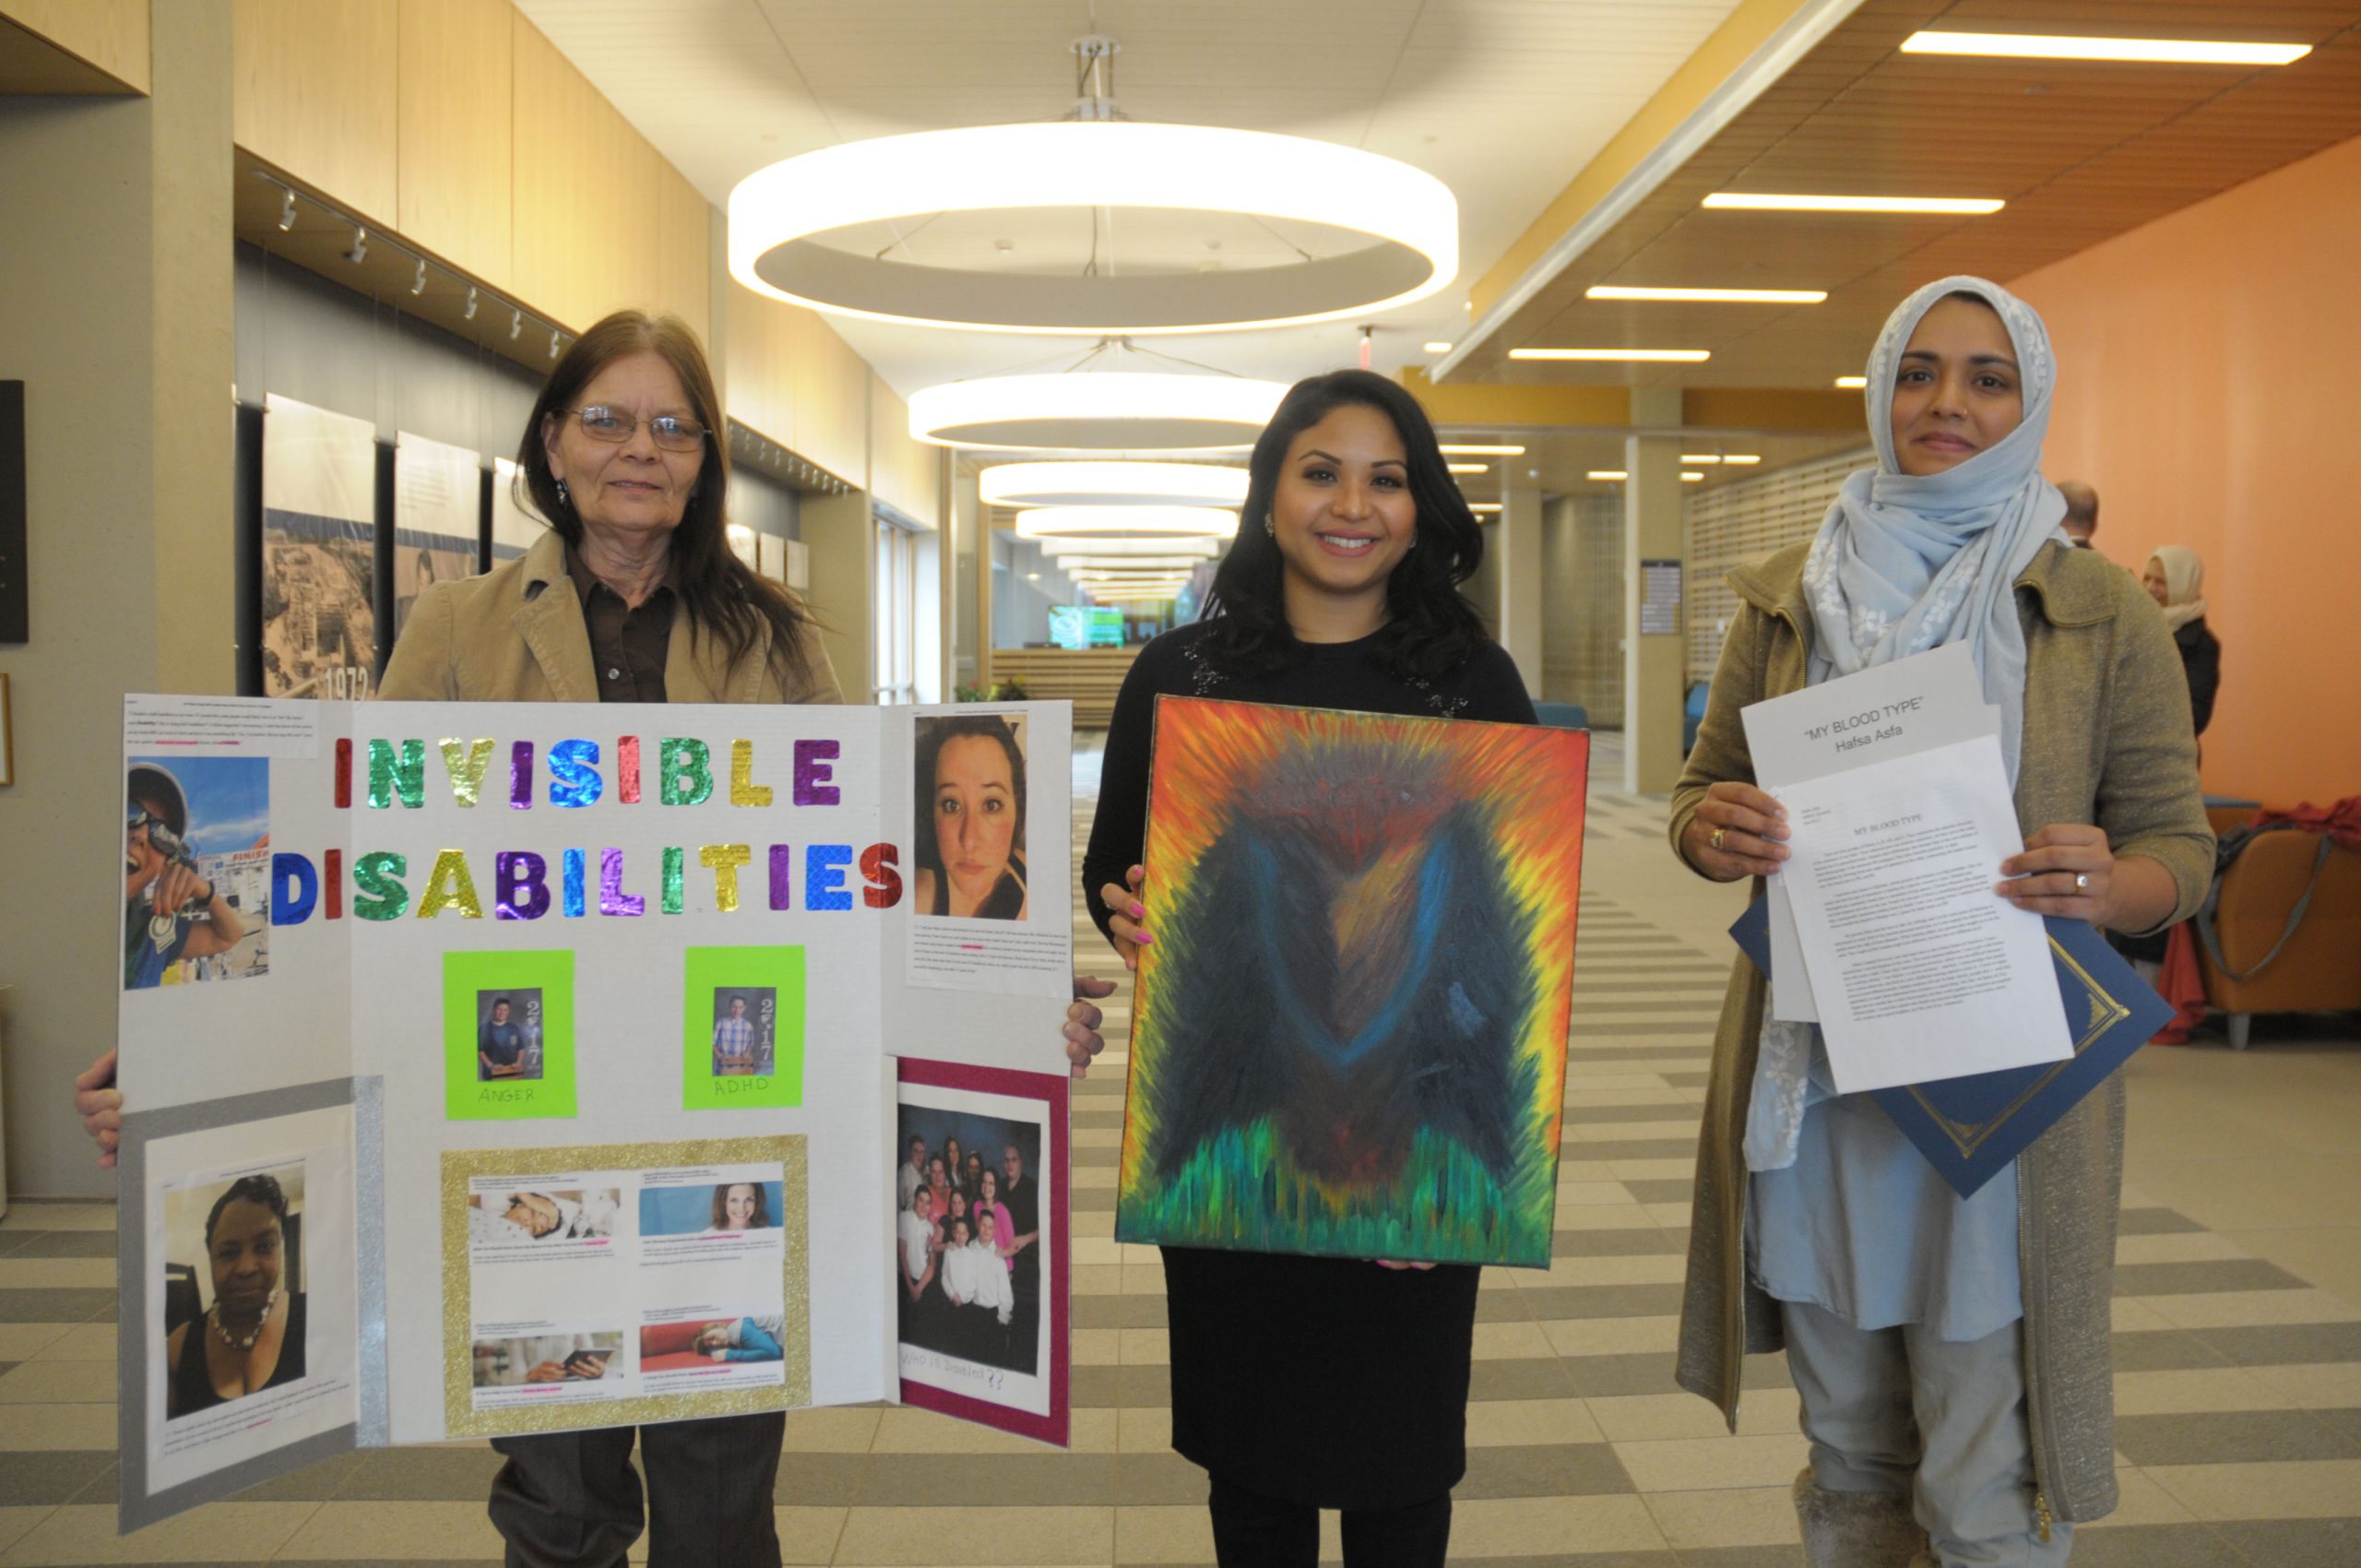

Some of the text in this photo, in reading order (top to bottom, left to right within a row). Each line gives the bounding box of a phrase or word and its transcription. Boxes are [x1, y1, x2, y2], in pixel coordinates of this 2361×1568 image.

[325, 666, 369, 701] 1972
[1833, 709, 1880, 733] BLOOD
[1835, 725, 1904, 753] Hafsa Asfa
[334, 736, 841, 809] INVISIBLE
[1854, 814, 1923, 837] MY BLOOD TYPE
[271, 842, 904, 926] DISABILITIES
[478, 1087, 535, 1102] ANGER
[715, 1077, 769, 1096] ADHD
